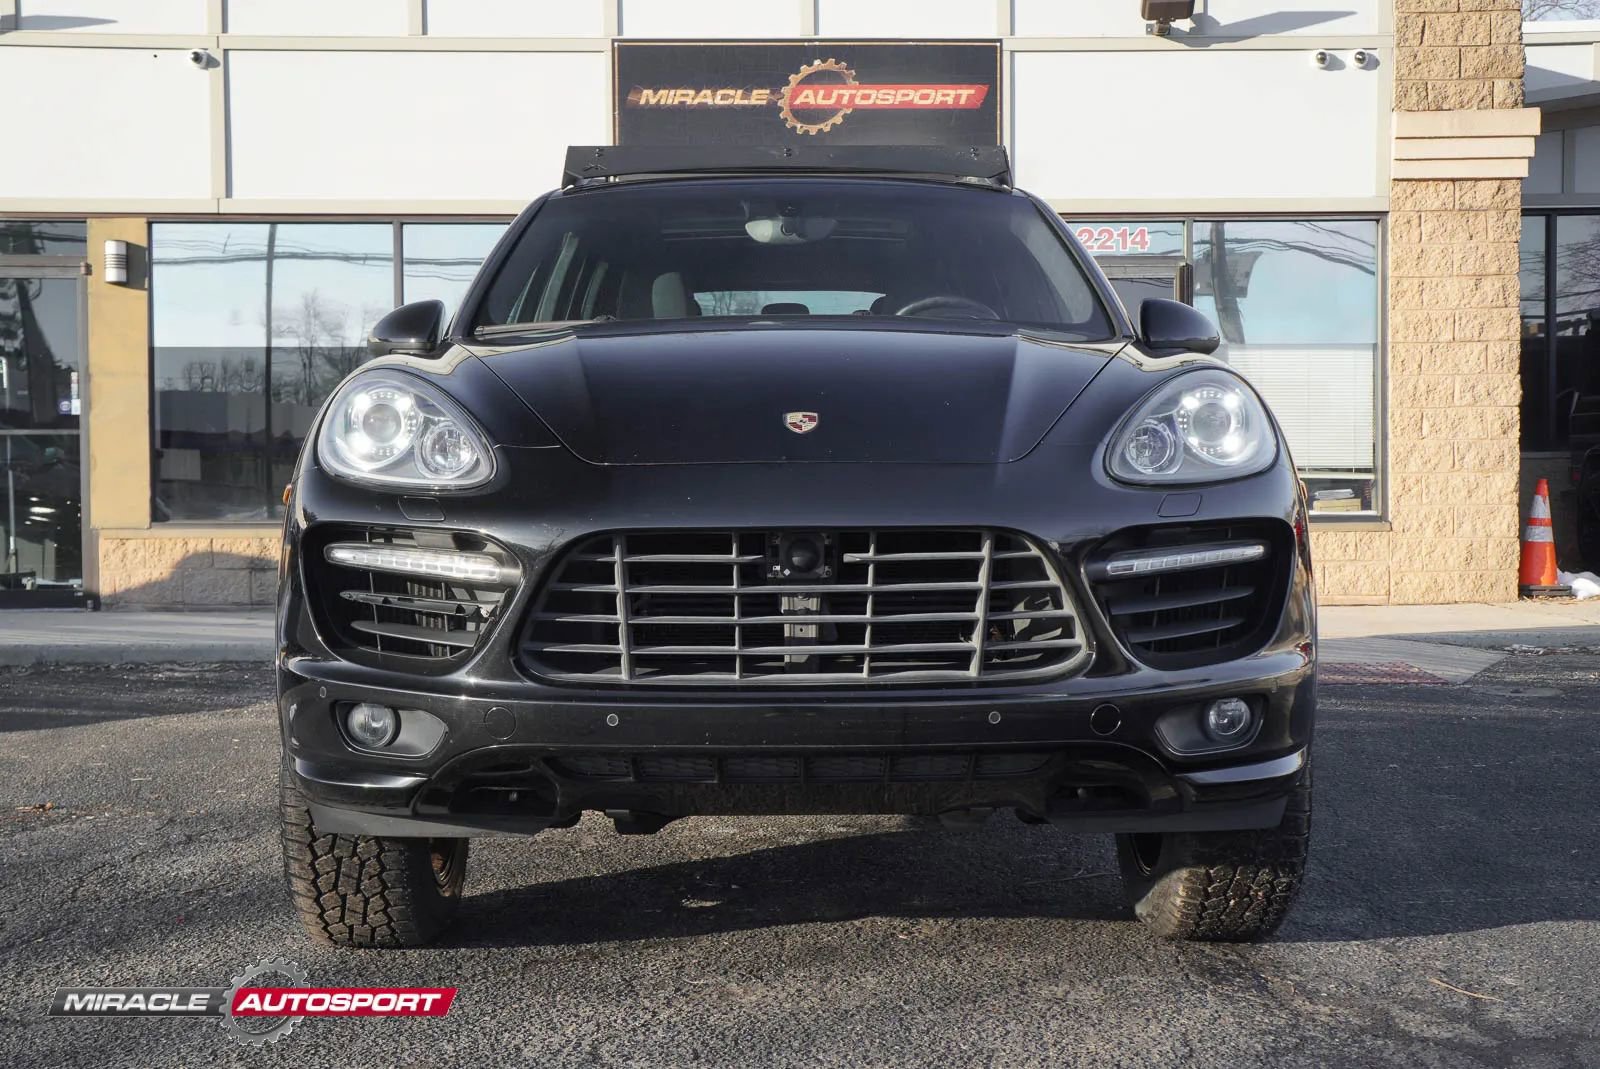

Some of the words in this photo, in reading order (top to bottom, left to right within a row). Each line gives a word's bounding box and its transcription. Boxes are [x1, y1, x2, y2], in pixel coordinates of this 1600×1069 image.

[639, 88, 771, 106] MIRACLE
[793, 87, 976, 106] AUTOSPORT
[1076, 227, 1150, 251] 2214
